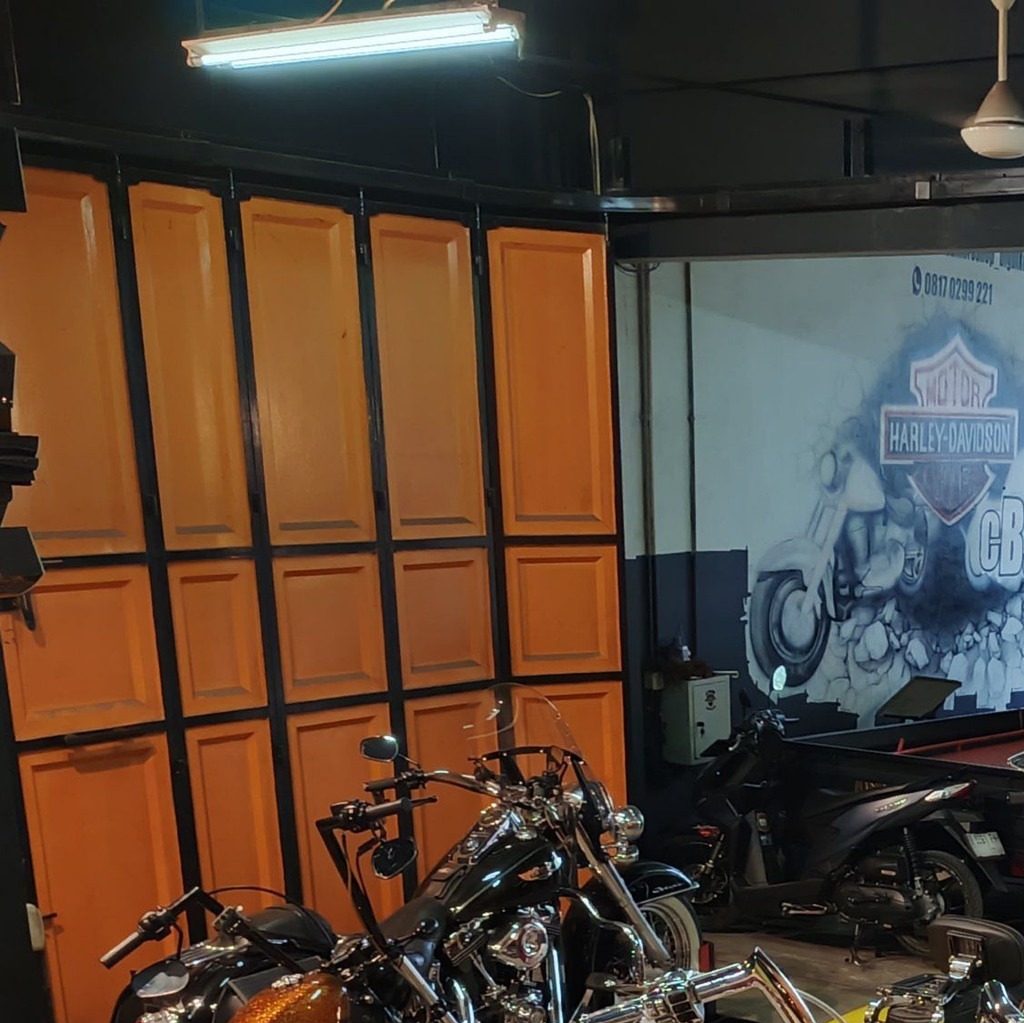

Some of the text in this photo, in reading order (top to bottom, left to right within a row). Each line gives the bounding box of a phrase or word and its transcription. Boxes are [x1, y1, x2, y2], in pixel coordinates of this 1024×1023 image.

[924, 272, 993, 306] 0817 0299 221
[926, 359, 980, 408] MOTOR
[889, 422, 1011, 453] HARLEY-DAVIDSON
